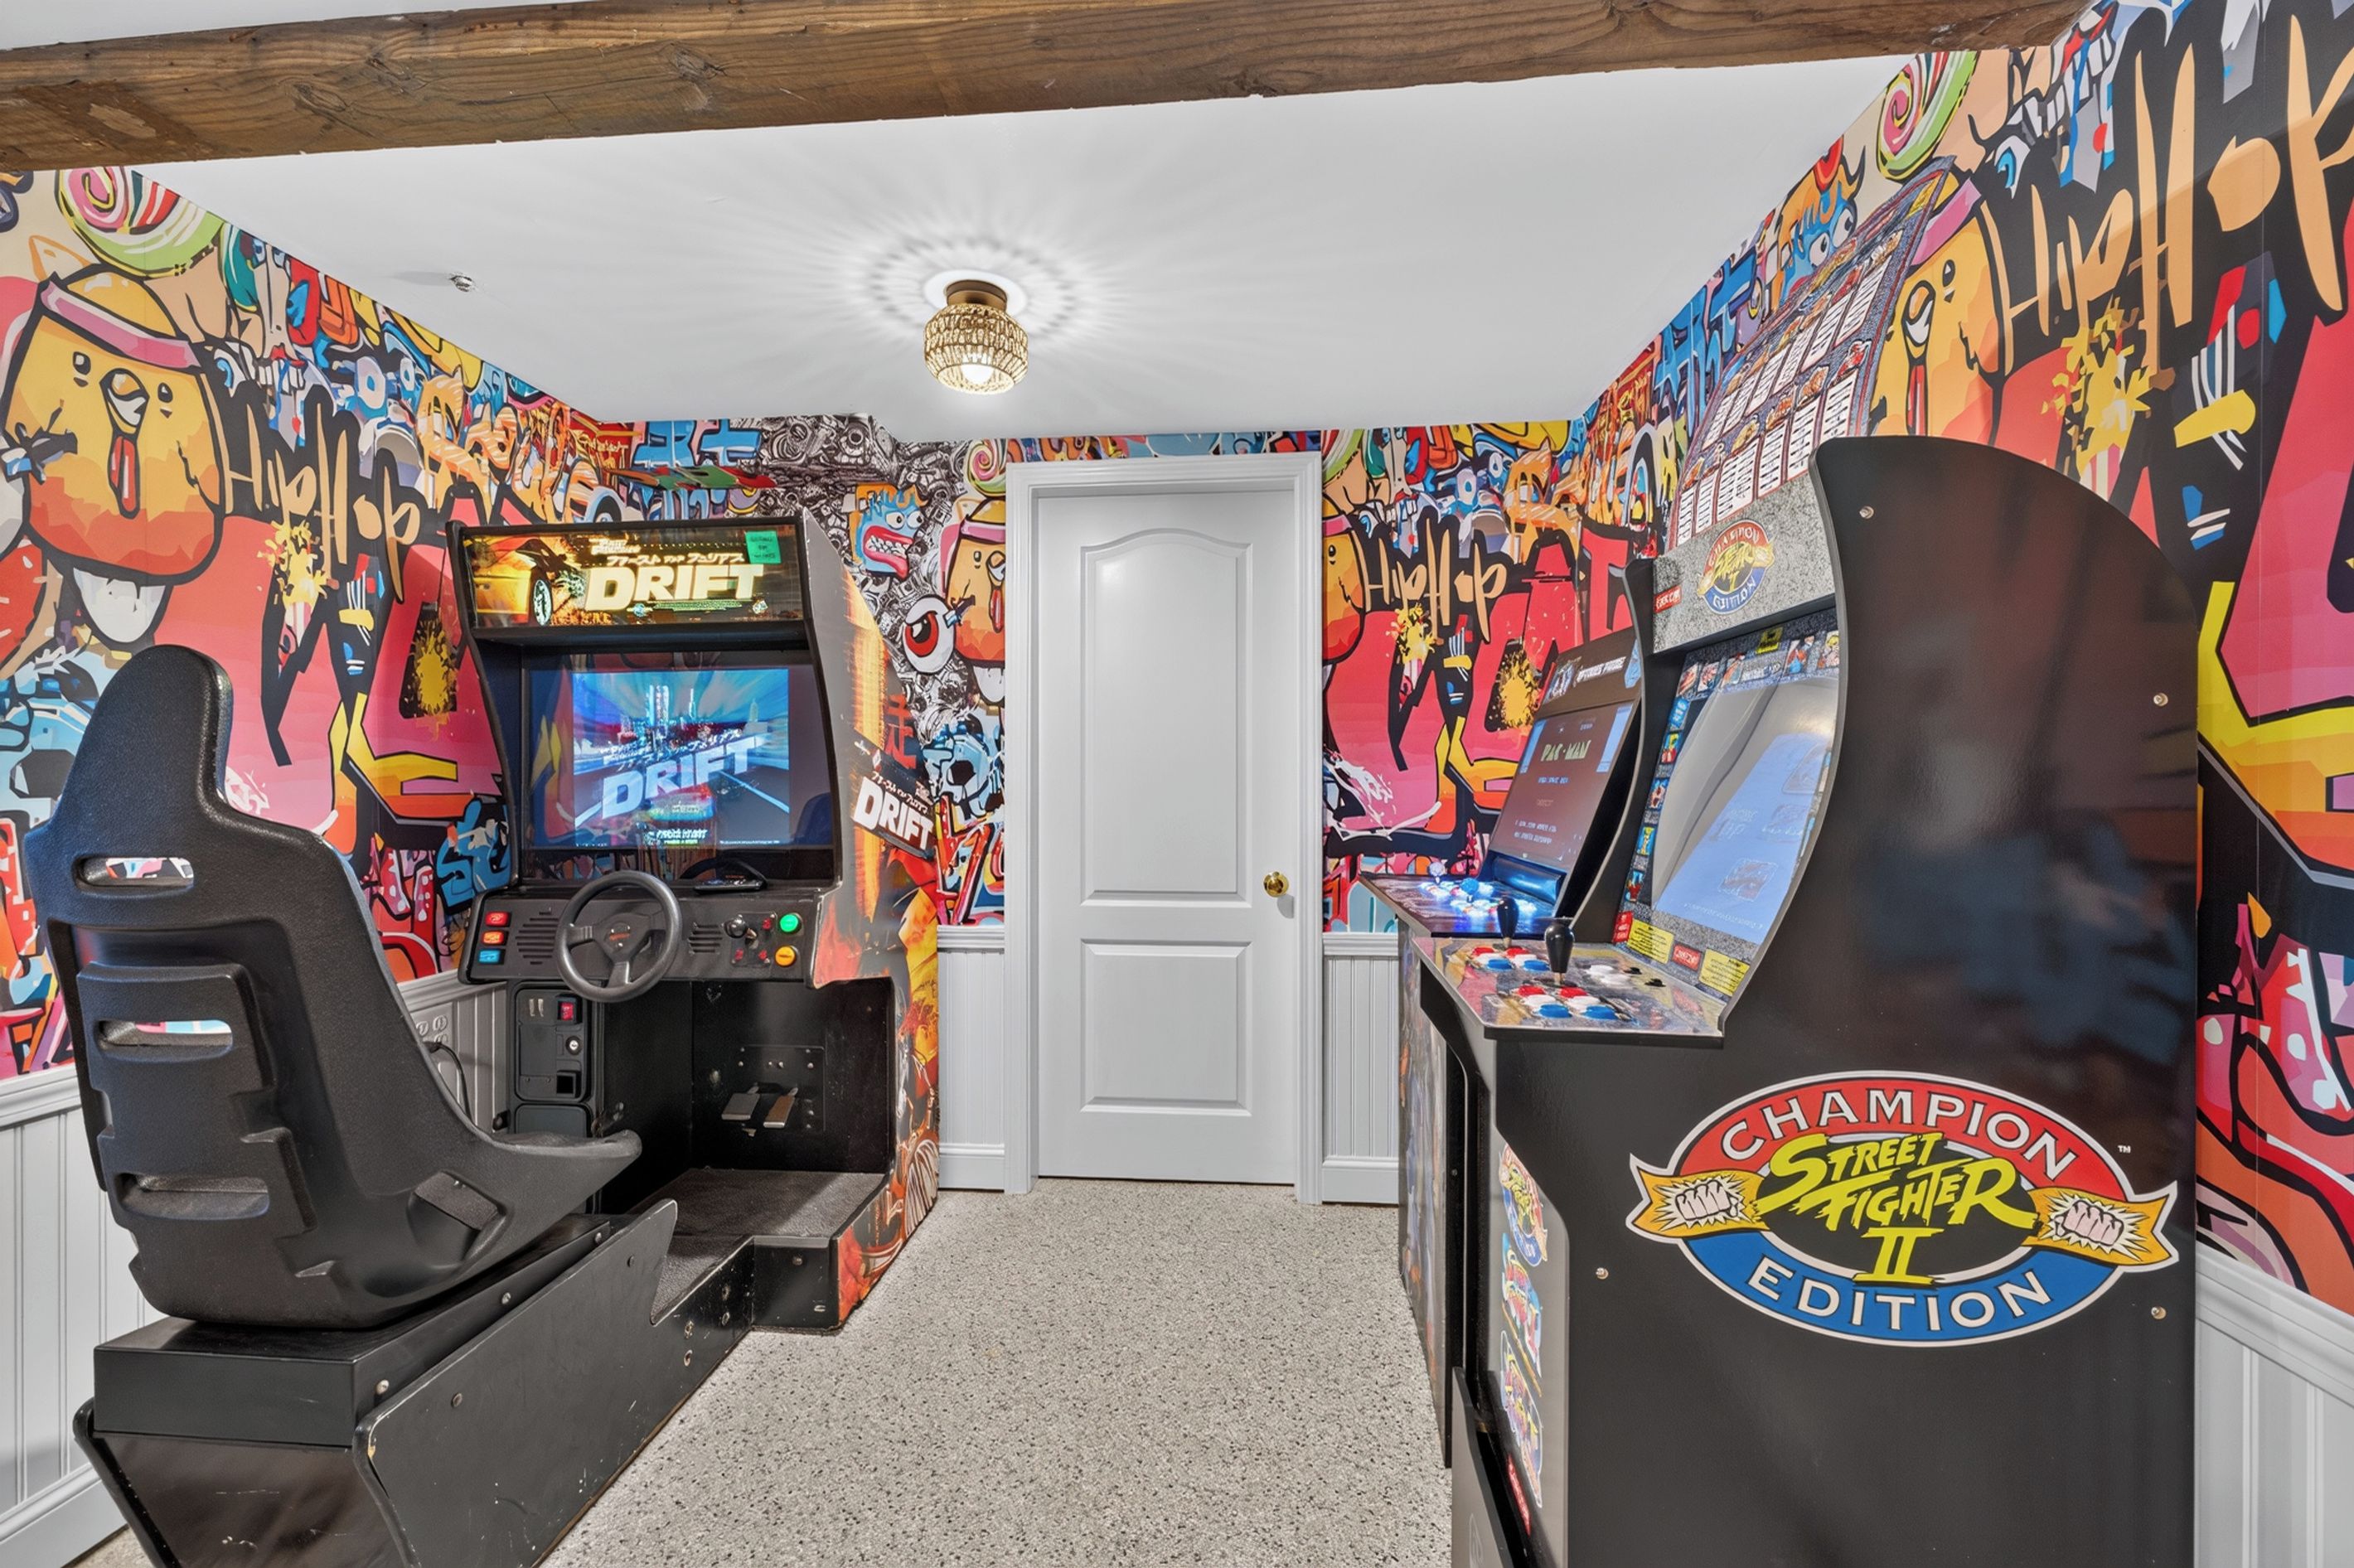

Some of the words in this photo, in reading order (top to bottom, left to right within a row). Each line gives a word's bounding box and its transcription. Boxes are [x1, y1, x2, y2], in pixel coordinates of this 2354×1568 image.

[586, 564, 764, 611] DRIFT
[603, 738, 755, 820] DRIFT
[854, 777, 934, 851] DRIFT
[1722, 1089, 2078, 1182] CHAMPION
[1756, 1132, 1945, 1220] STREET
[1792, 1156, 2040, 1232] FIGHTER
[1747, 1255, 2051, 1333] EDITION
[1853, 1227, 1942, 1285] II
